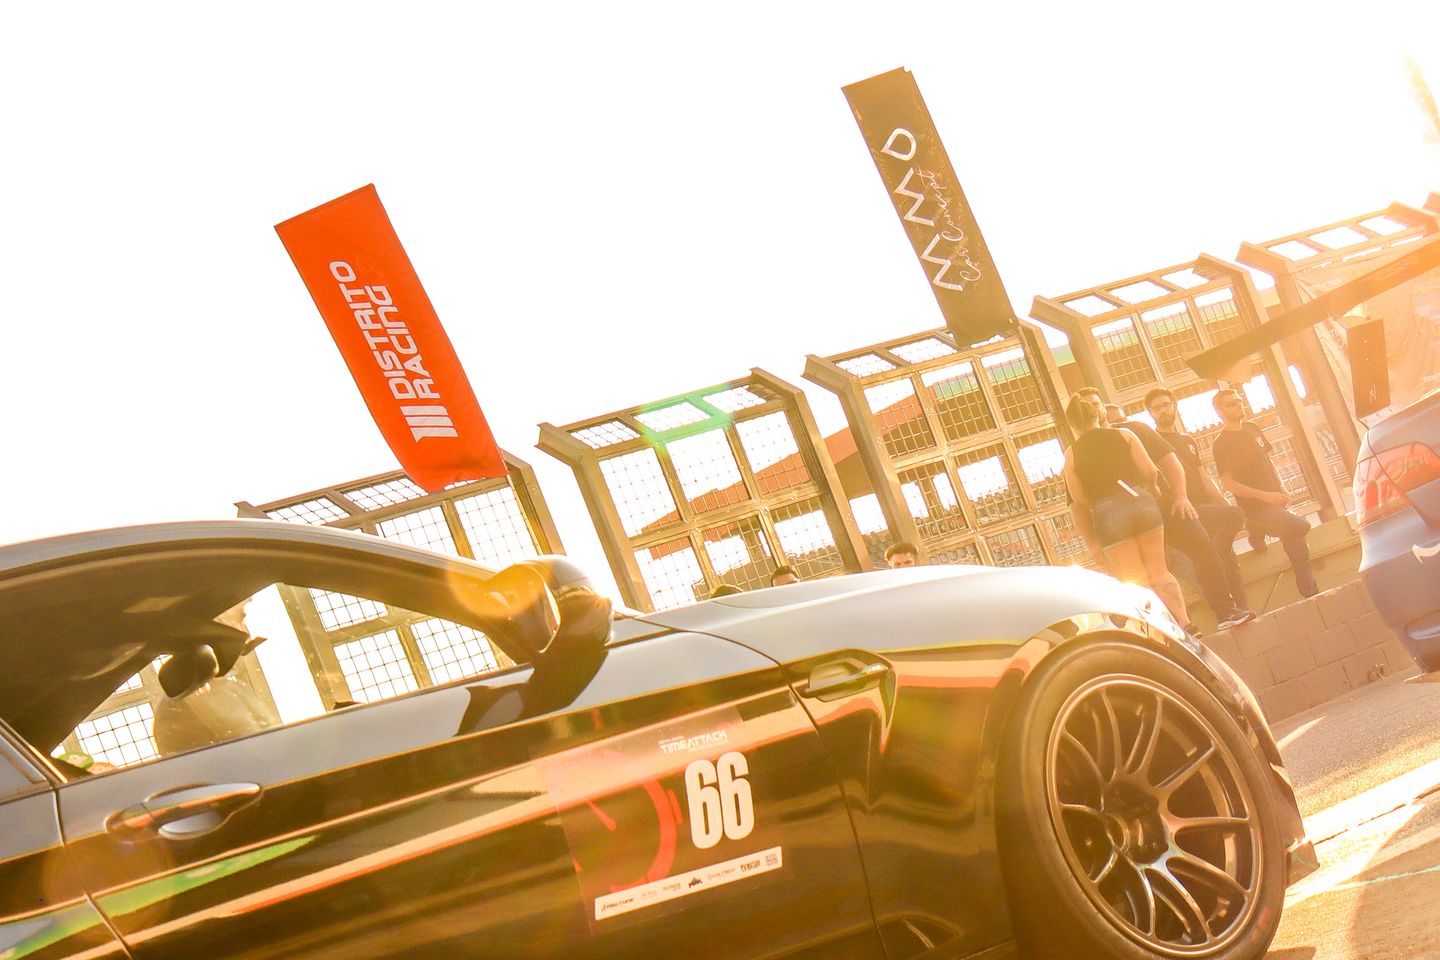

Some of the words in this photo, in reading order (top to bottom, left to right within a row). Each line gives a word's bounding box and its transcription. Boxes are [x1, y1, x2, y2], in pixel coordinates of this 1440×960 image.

[329, 261, 417, 400] DISTRITO
[364, 285, 441, 399] RACING
[684, 751, 755, 849] 66
